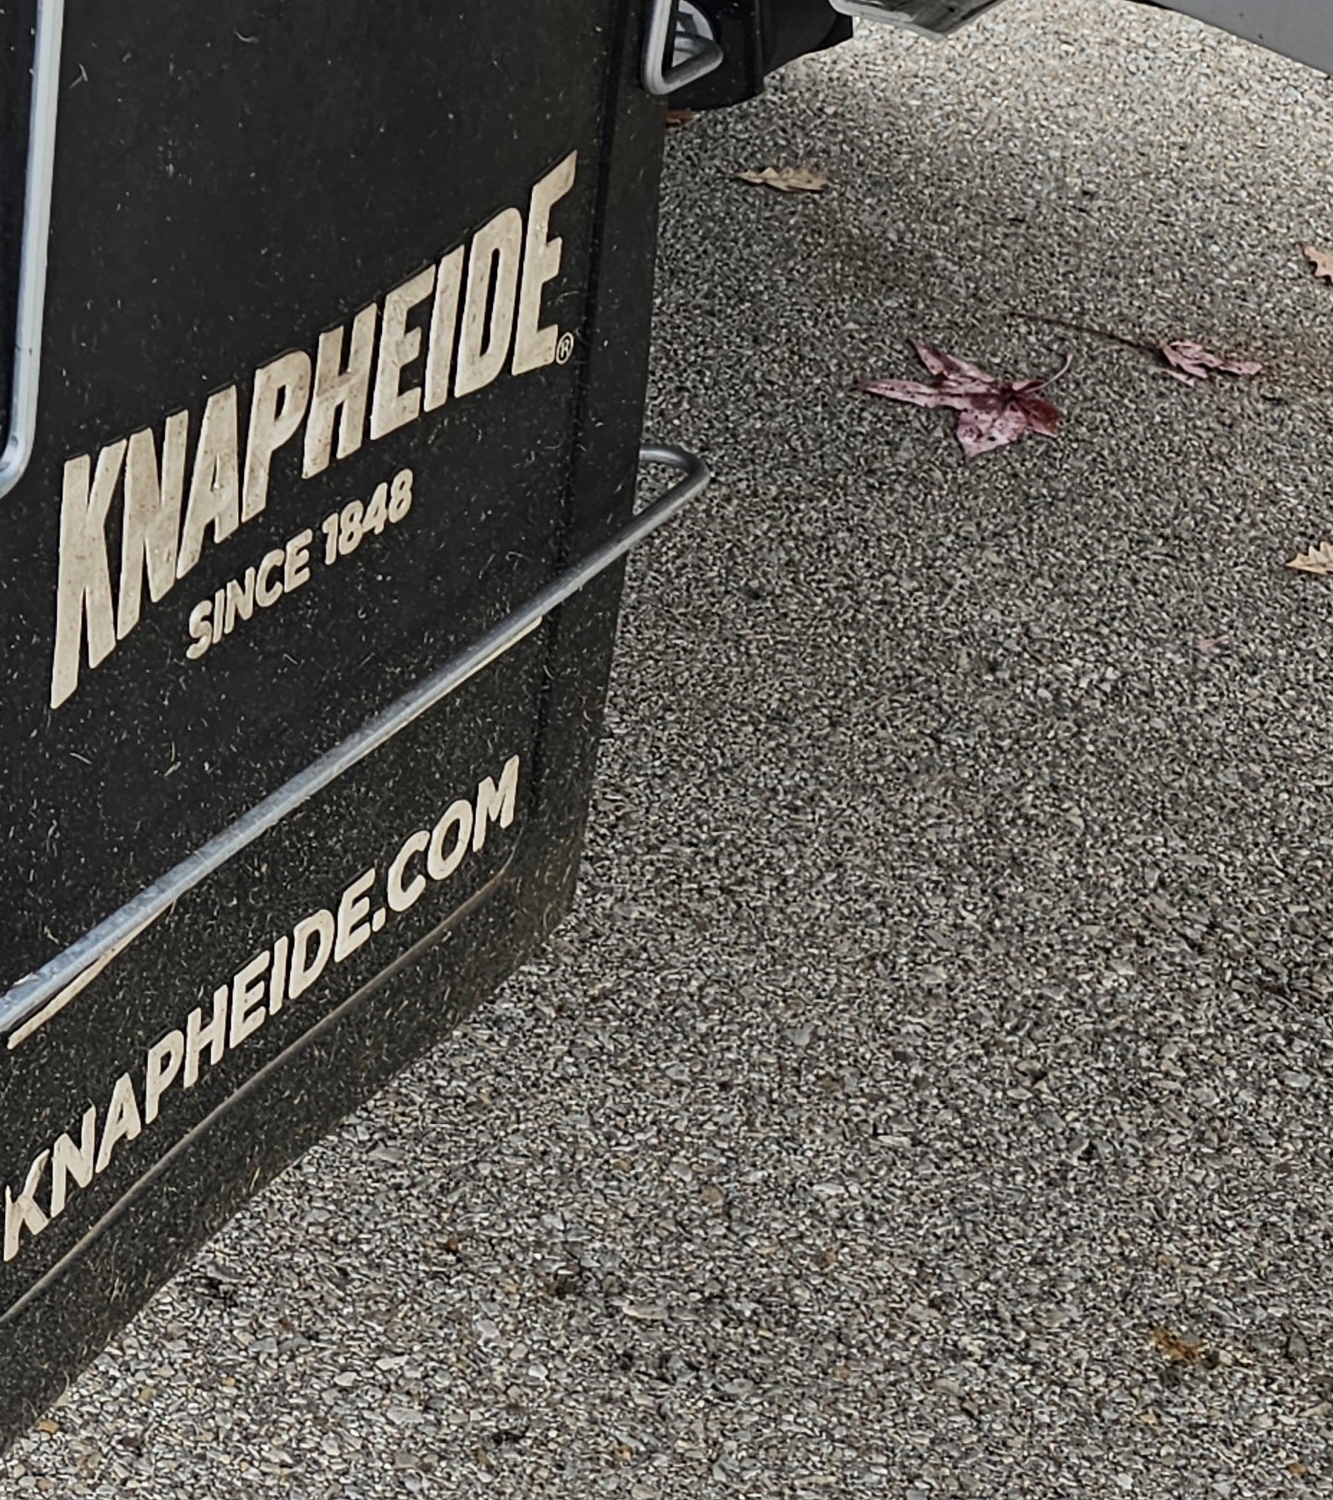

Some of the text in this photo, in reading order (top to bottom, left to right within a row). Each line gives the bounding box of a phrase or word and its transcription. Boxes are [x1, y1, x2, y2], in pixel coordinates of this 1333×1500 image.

[49, 150, 577, 710] KNAPHEIDE
[185, 468, 414, 661] SINCE 1848
[2, 753, 521, 1263] KNAPHEIDE.COM
